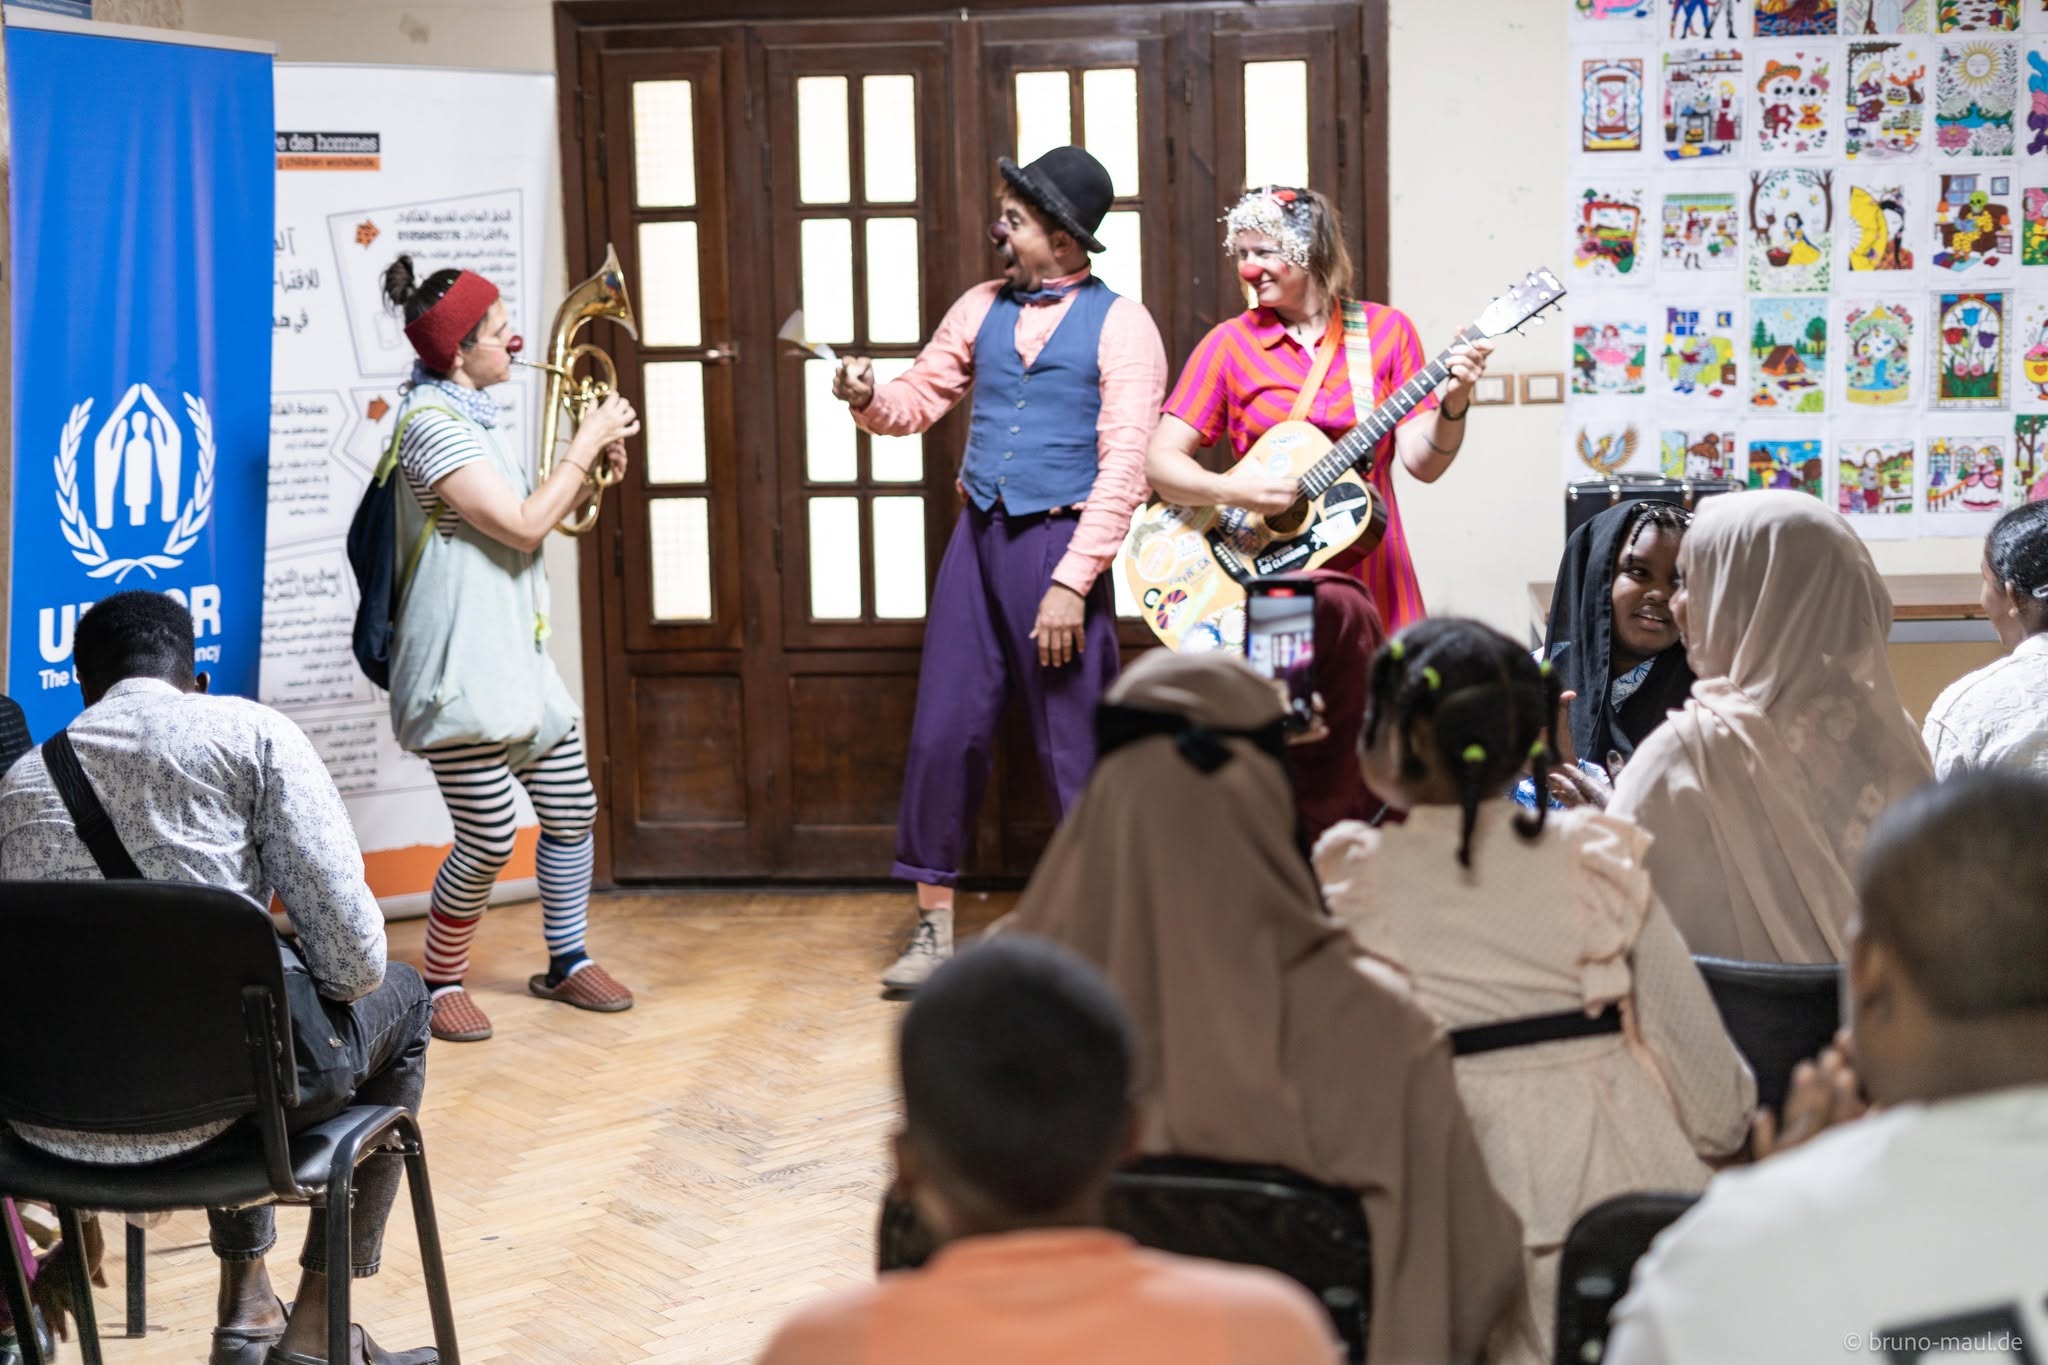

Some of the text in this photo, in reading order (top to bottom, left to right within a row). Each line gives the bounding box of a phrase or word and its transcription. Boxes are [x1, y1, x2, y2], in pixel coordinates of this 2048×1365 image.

[288, 133, 315, 152] des
[316, 133, 378, 152] hommes
[38, 667, 70, 690] The
